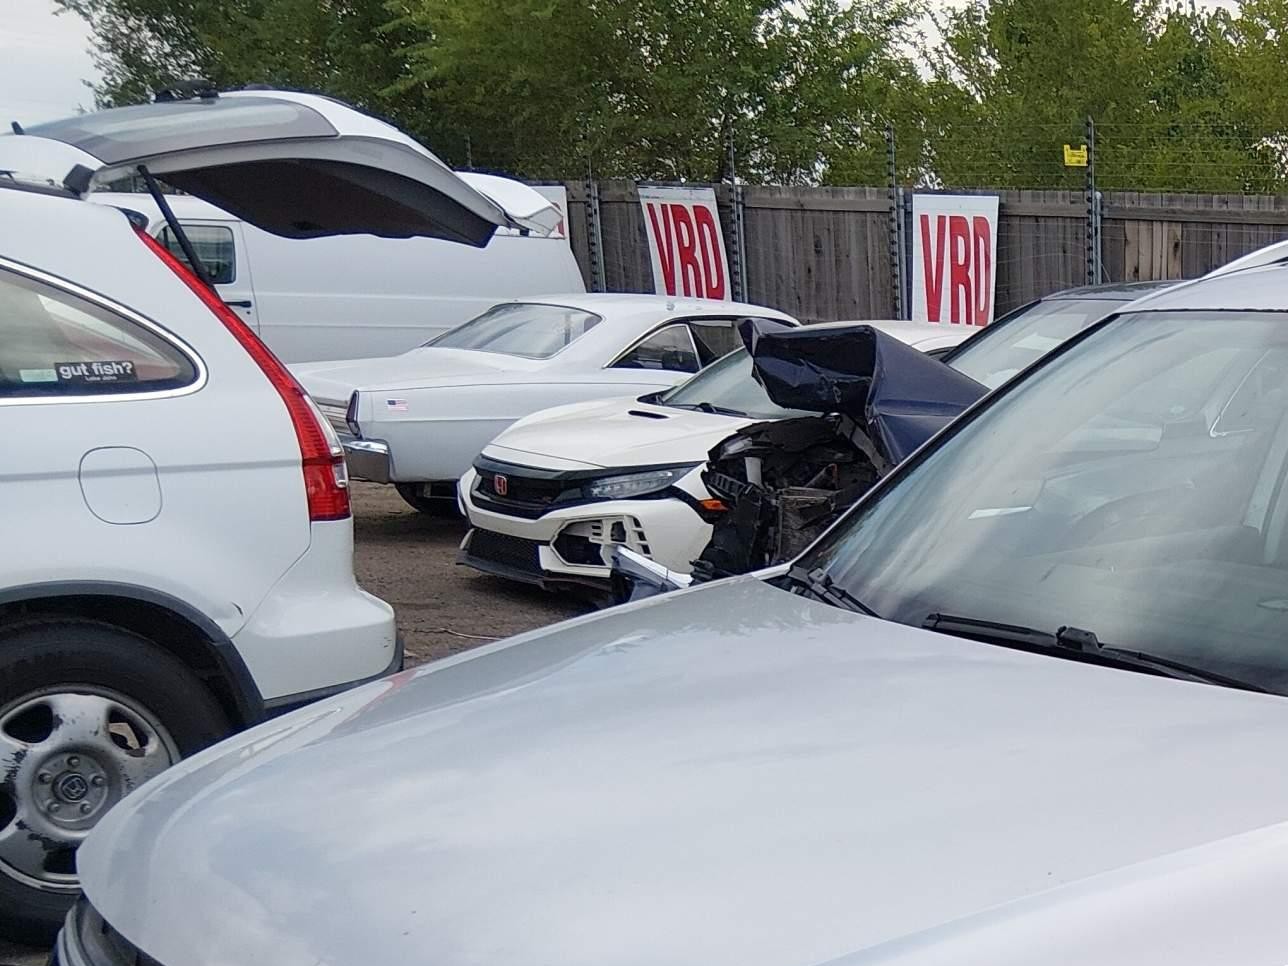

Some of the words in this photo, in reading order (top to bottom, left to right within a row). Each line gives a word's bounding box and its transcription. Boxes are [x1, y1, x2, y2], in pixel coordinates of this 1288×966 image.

[646, 202, 725, 301] VRD
[919, 214, 993, 327] VRD
[60, 363, 89, 380] gut
[91, 361, 133, 375] fish?
